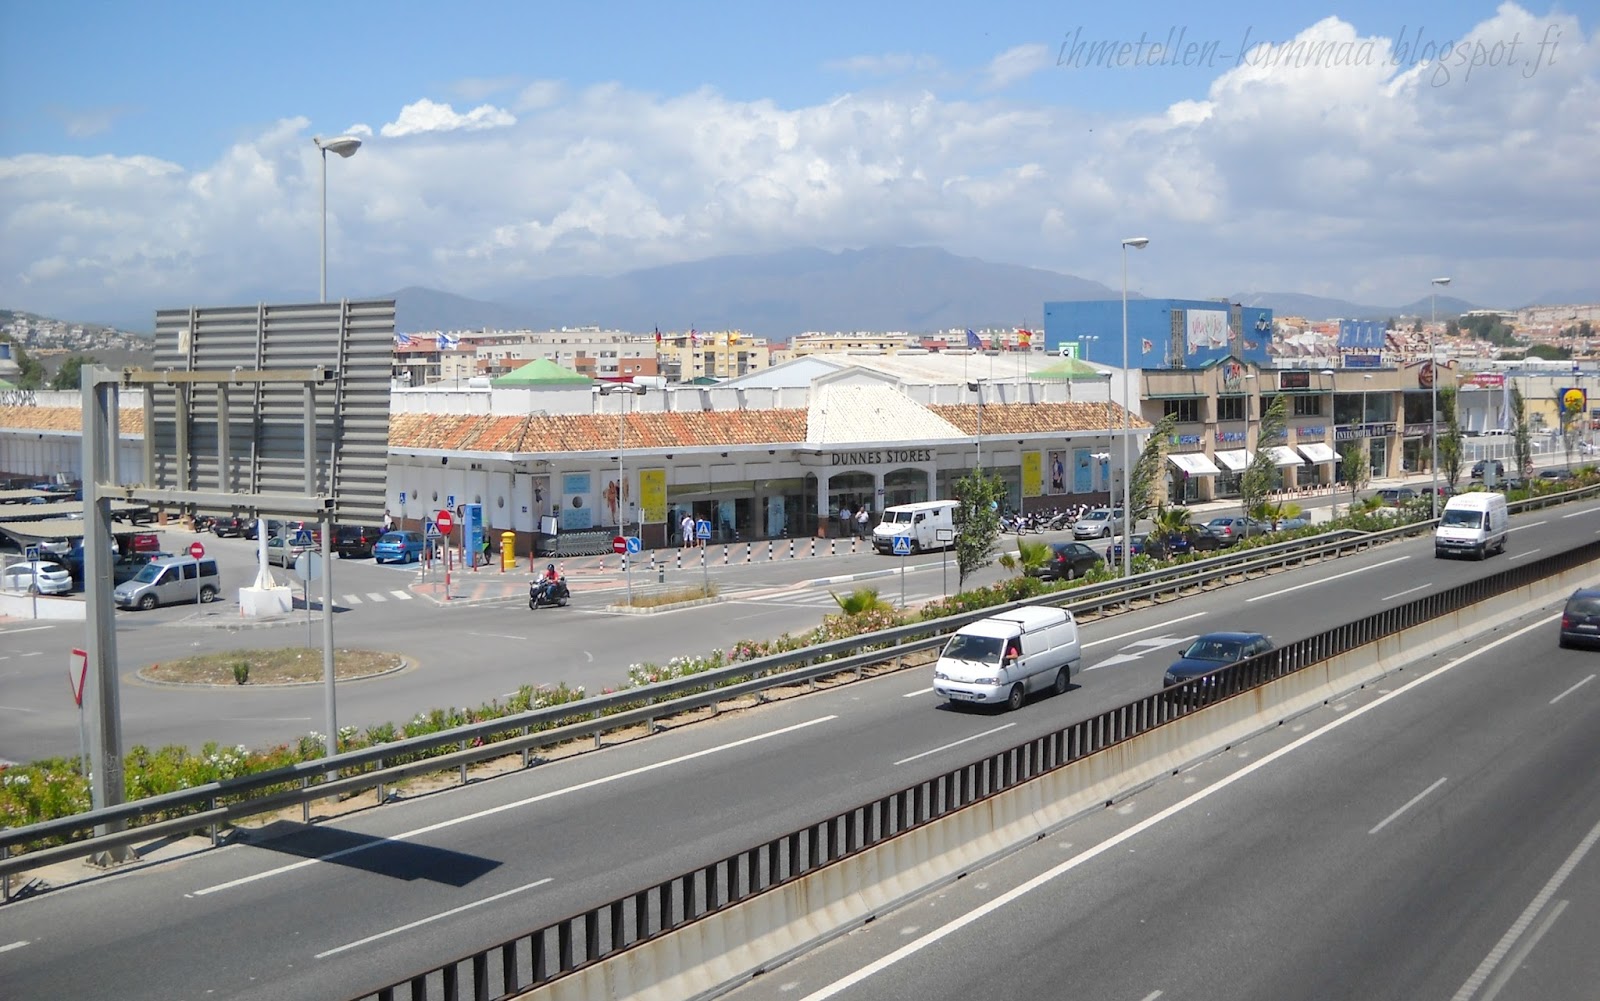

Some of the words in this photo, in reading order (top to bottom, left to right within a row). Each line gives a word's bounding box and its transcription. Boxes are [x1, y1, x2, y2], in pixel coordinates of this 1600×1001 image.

[1341, 326, 1385, 343] FIAT
[832, 452, 882, 466] DUNNES
[887, 449, 931, 463] STORES
